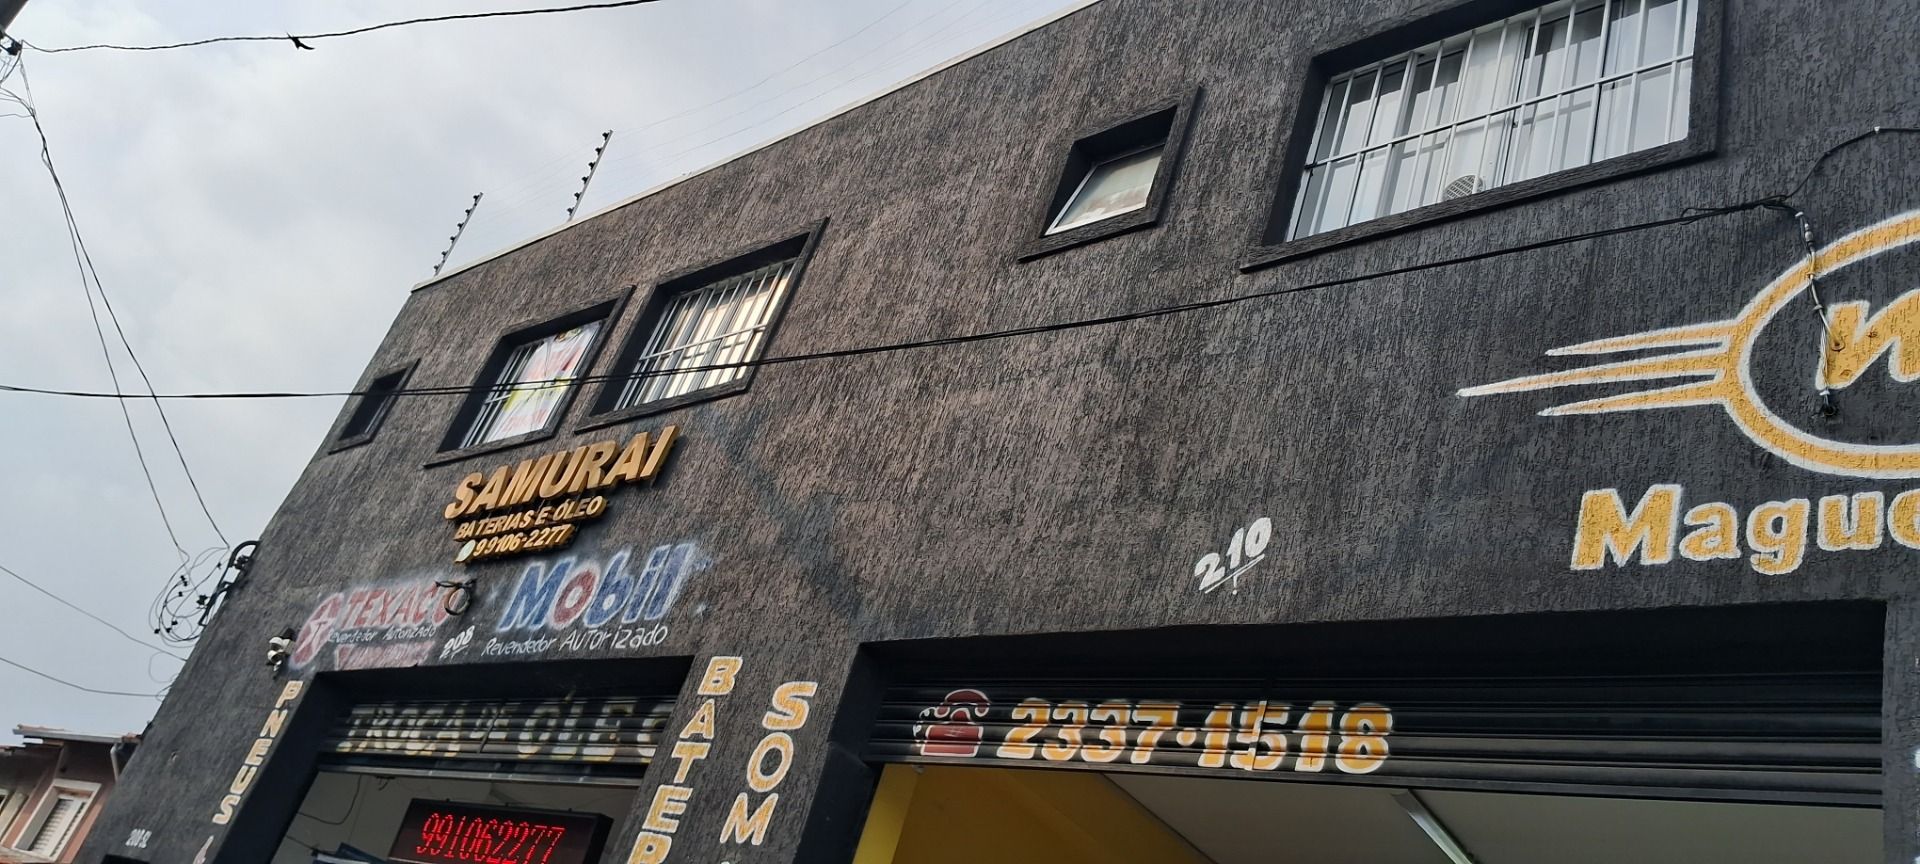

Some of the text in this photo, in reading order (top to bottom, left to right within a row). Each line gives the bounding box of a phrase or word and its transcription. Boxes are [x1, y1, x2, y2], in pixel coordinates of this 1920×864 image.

[444, 425, 680, 520] SAMURAI
[454, 495, 607, 540] BATERIAS E ÓLEO
[473, 524, 575, 556] 99106-2277
[1194, 517, 1272, 591] 210
[341, 580, 468, 630] TEXACO
[496, 542, 697, 632] Mobil
[440, 625, 475, 658] 208
[481, 633, 557, 656] Revendedor
[212, 680, 304, 825] PNEUS
[719, 681, 818, 845] SOM
[416, 812, 566, 864] 991062277
